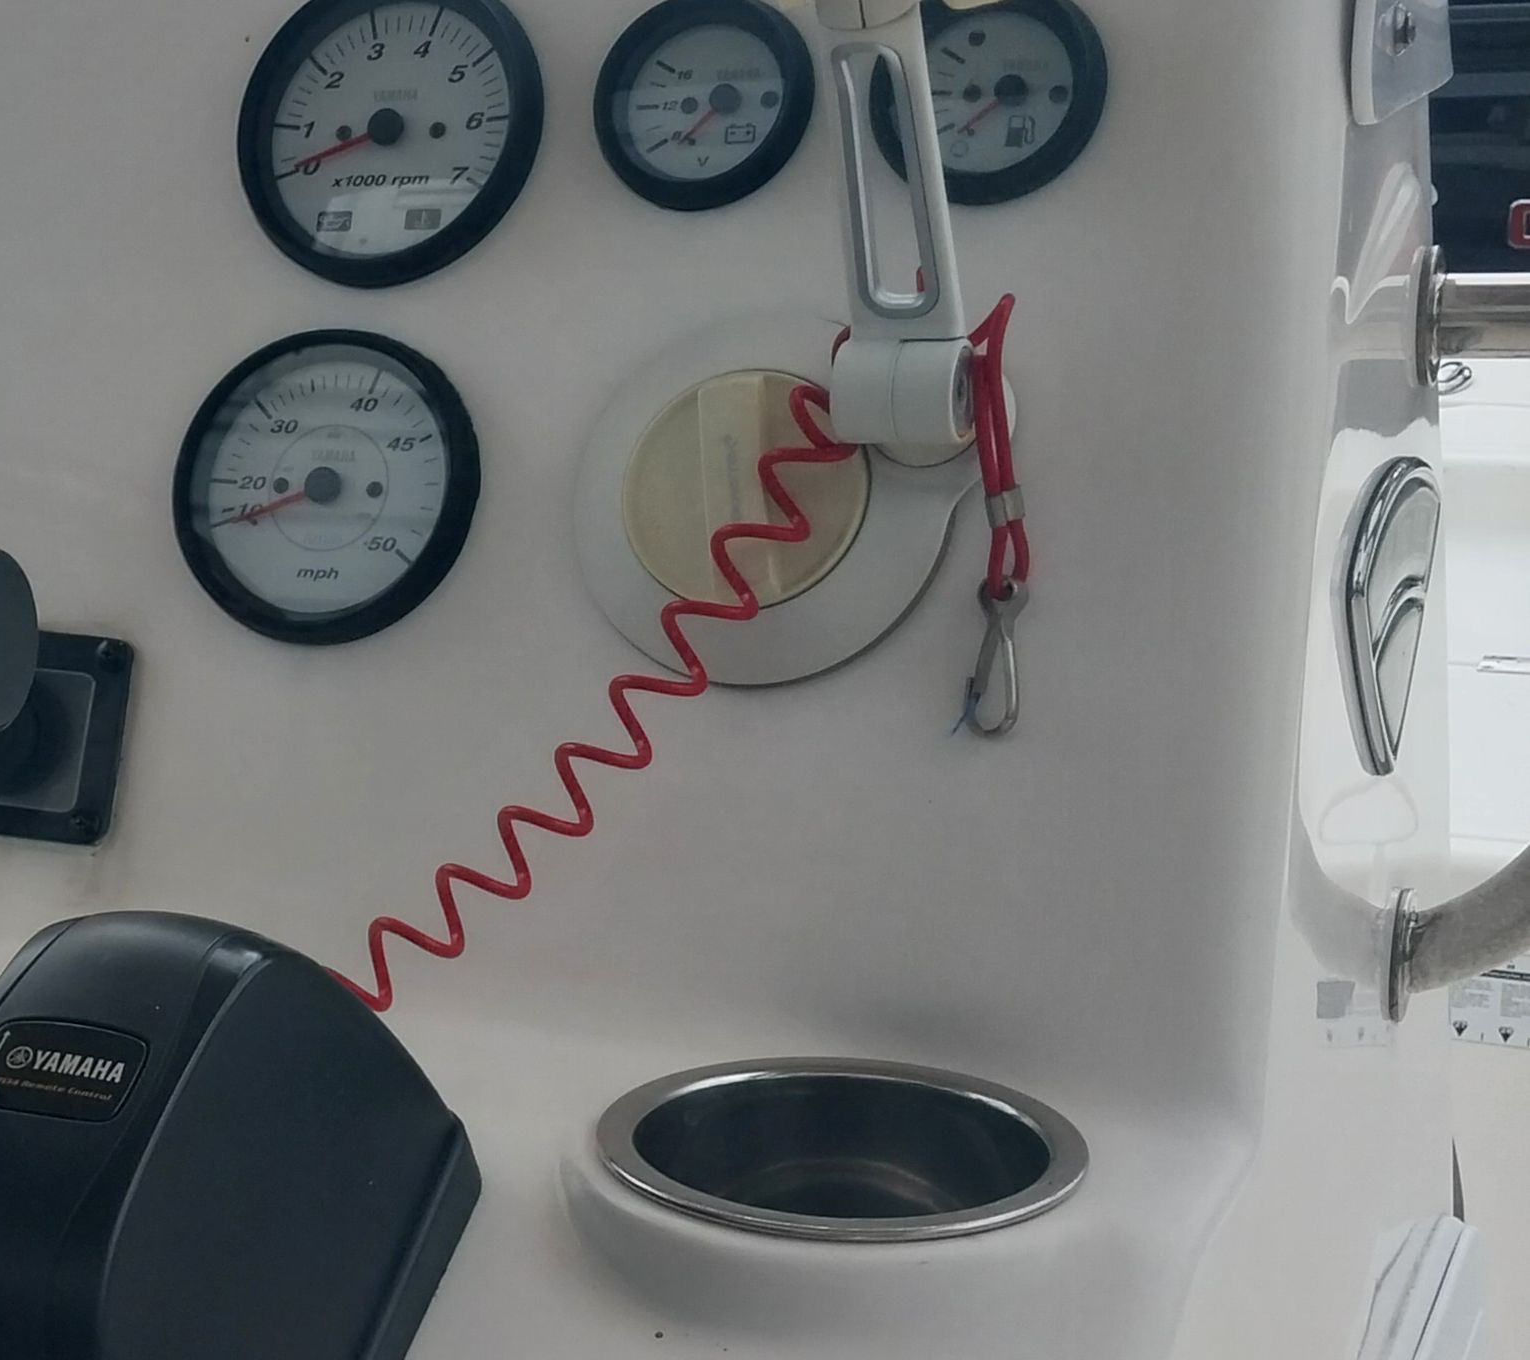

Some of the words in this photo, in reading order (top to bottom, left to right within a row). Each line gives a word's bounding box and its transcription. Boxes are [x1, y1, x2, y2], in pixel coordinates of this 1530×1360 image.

[366, 42, 385, 61] 3
[413, 40, 432, 58] 4
[324, 72, 344, 89] 2
[448, 65, 468, 84] 5
[677, 70, 693, 80] 16
[661, 101, 678, 111] 12
[302, 121, 316, 138] 1
[466, 112, 485, 130] 6
[331, 174, 386, 188] x1000
[391, 174, 429, 187] rpm
[449, 166, 469, 184] 7
[350, 397, 378, 412] 40
[270, 419, 298, 434] 30
[386, 436, 415, 452] 45
[237, 476, 266, 490] 20
[368, 536, 396, 553] 50
[296, 566, 339, 581] mph
[33, 1050, 125, 1083] YAMAHA
